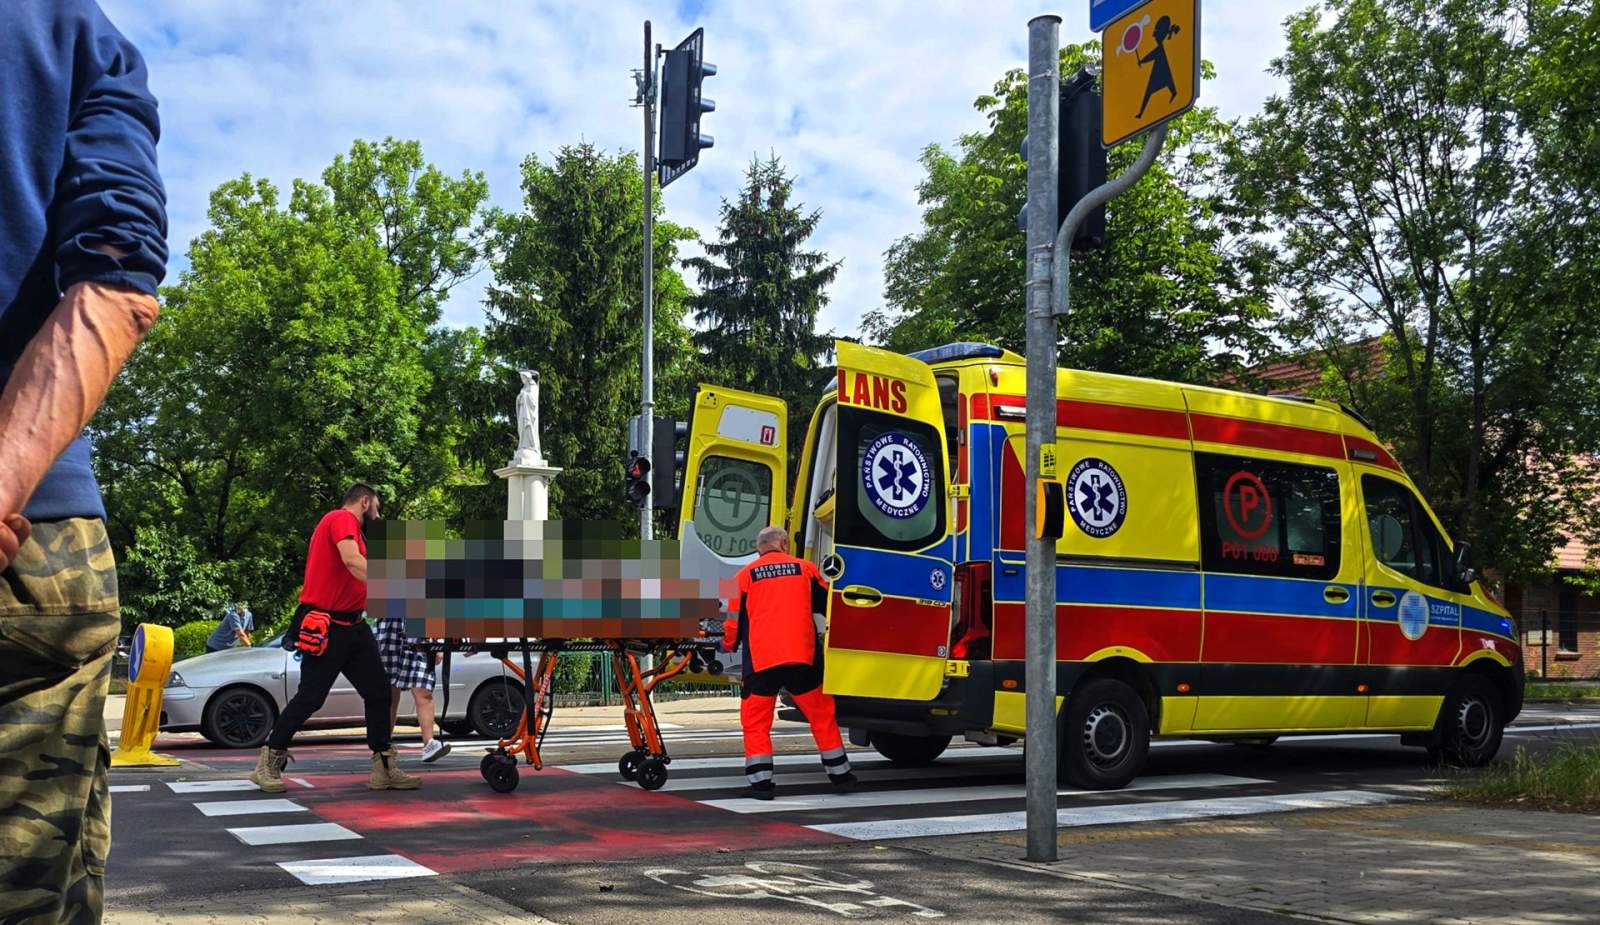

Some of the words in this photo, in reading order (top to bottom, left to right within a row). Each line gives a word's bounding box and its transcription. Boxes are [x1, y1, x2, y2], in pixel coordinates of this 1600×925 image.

[837, 368, 908, 414] LANS
[902, 438, 930, 497] RATOWNICTWO
[876, 498, 920, 517] MEDYCZNE
[1239, 484, 1258, 523] P
[1080, 520, 1118, 536] MEDYCZNE
[755, 563, 796, 573] RATOWNIK
[756, 569, 797, 580] MEDYCZNY
[1431, 604, 1459, 616] SZPITAL
